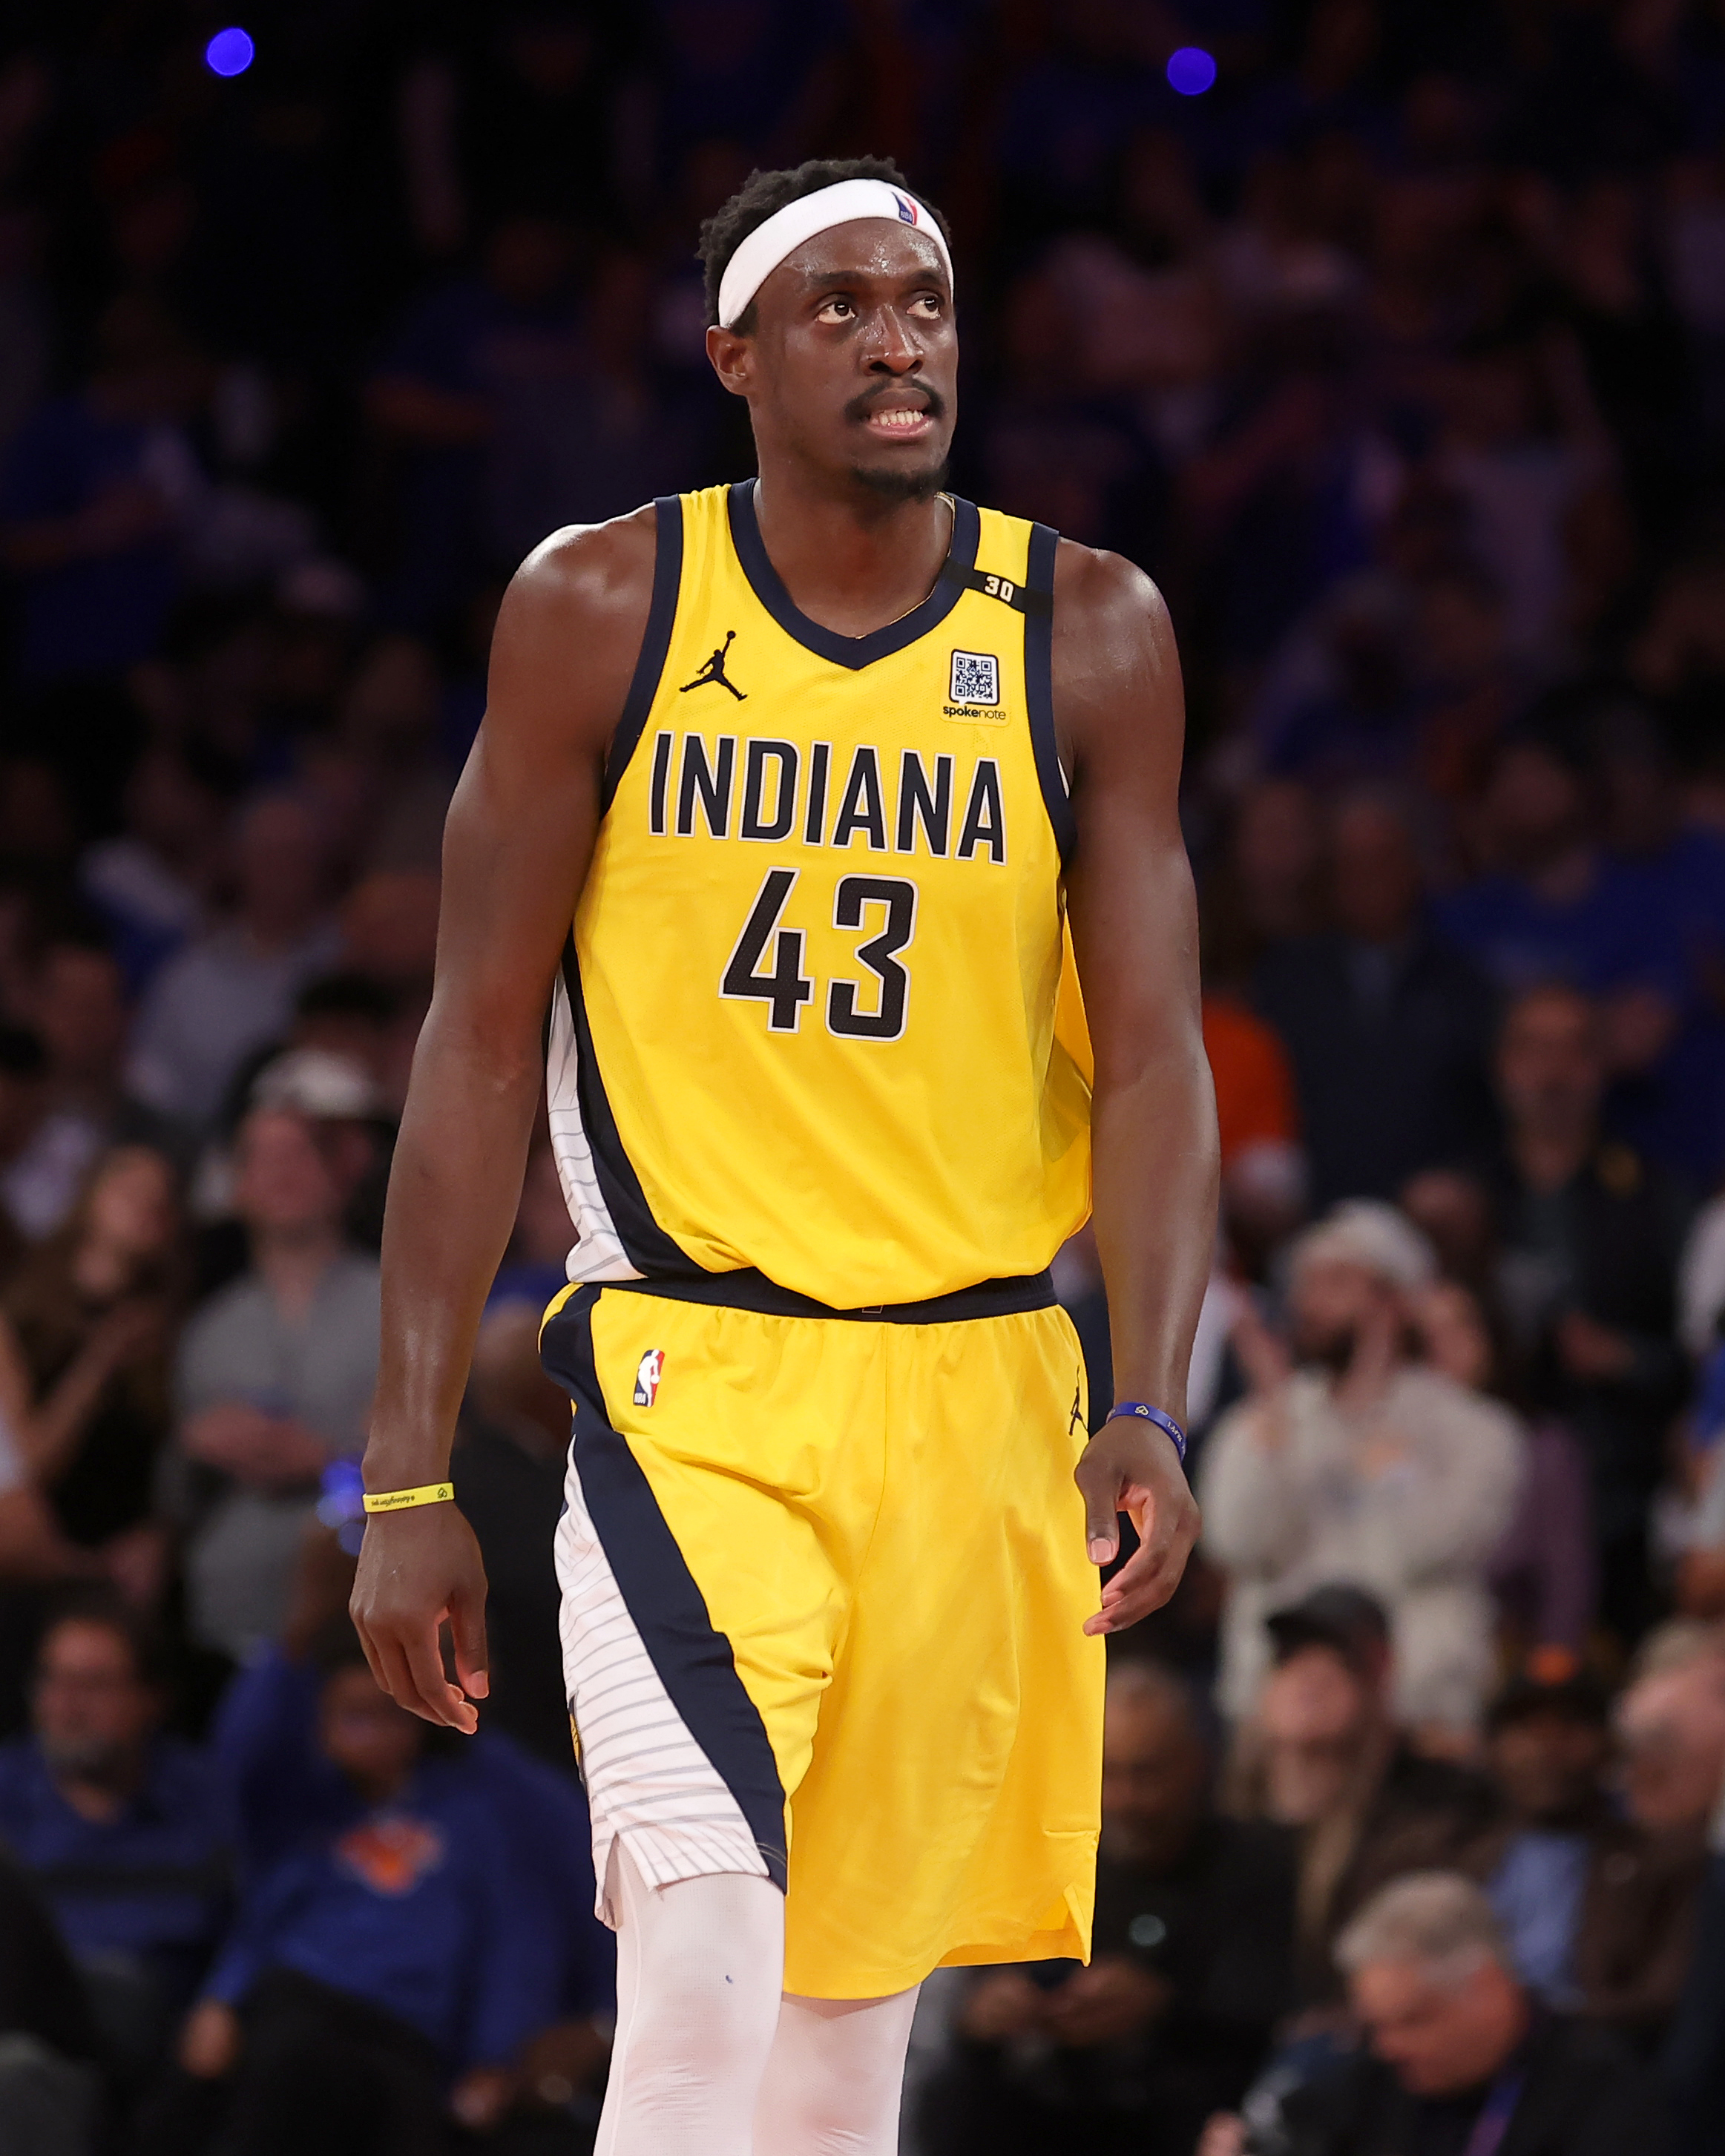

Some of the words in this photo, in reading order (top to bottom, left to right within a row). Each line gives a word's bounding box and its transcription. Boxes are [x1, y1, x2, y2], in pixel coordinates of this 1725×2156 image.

[985, 575, 1014, 602] 30
[943, 706, 1006, 720] spokenote
[648, 730, 1008, 866] INDIANA
[718, 866, 919, 1042] 43
[634, 1393, 646, 1404] NBA
